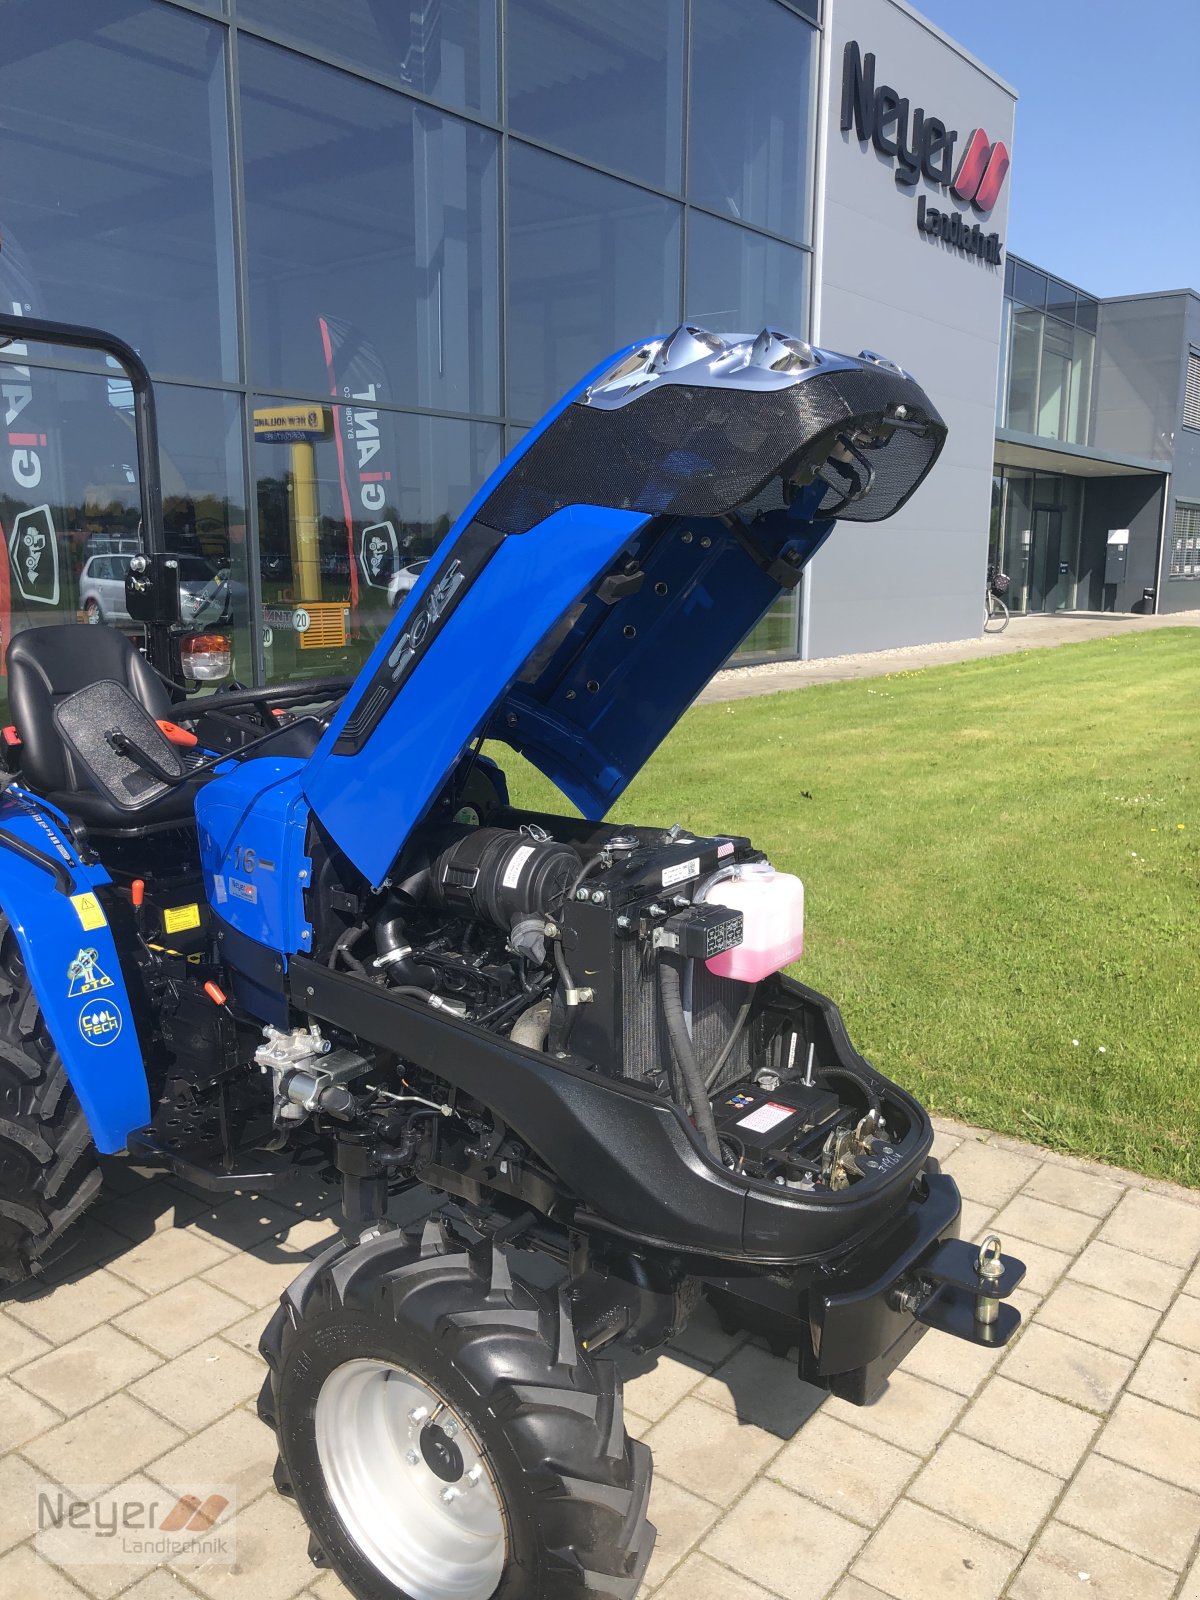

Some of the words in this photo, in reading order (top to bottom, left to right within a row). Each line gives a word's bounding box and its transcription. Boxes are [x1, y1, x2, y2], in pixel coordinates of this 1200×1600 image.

[841, 40, 957, 187] Neyer
[917, 195, 1003, 265] Landtechnik
[296, 613, 307, 628] 20
[234, 845, 256, 873] 16
[81, 976, 111, 994] PTO
[84, 1019, 118, 1037] TECH
